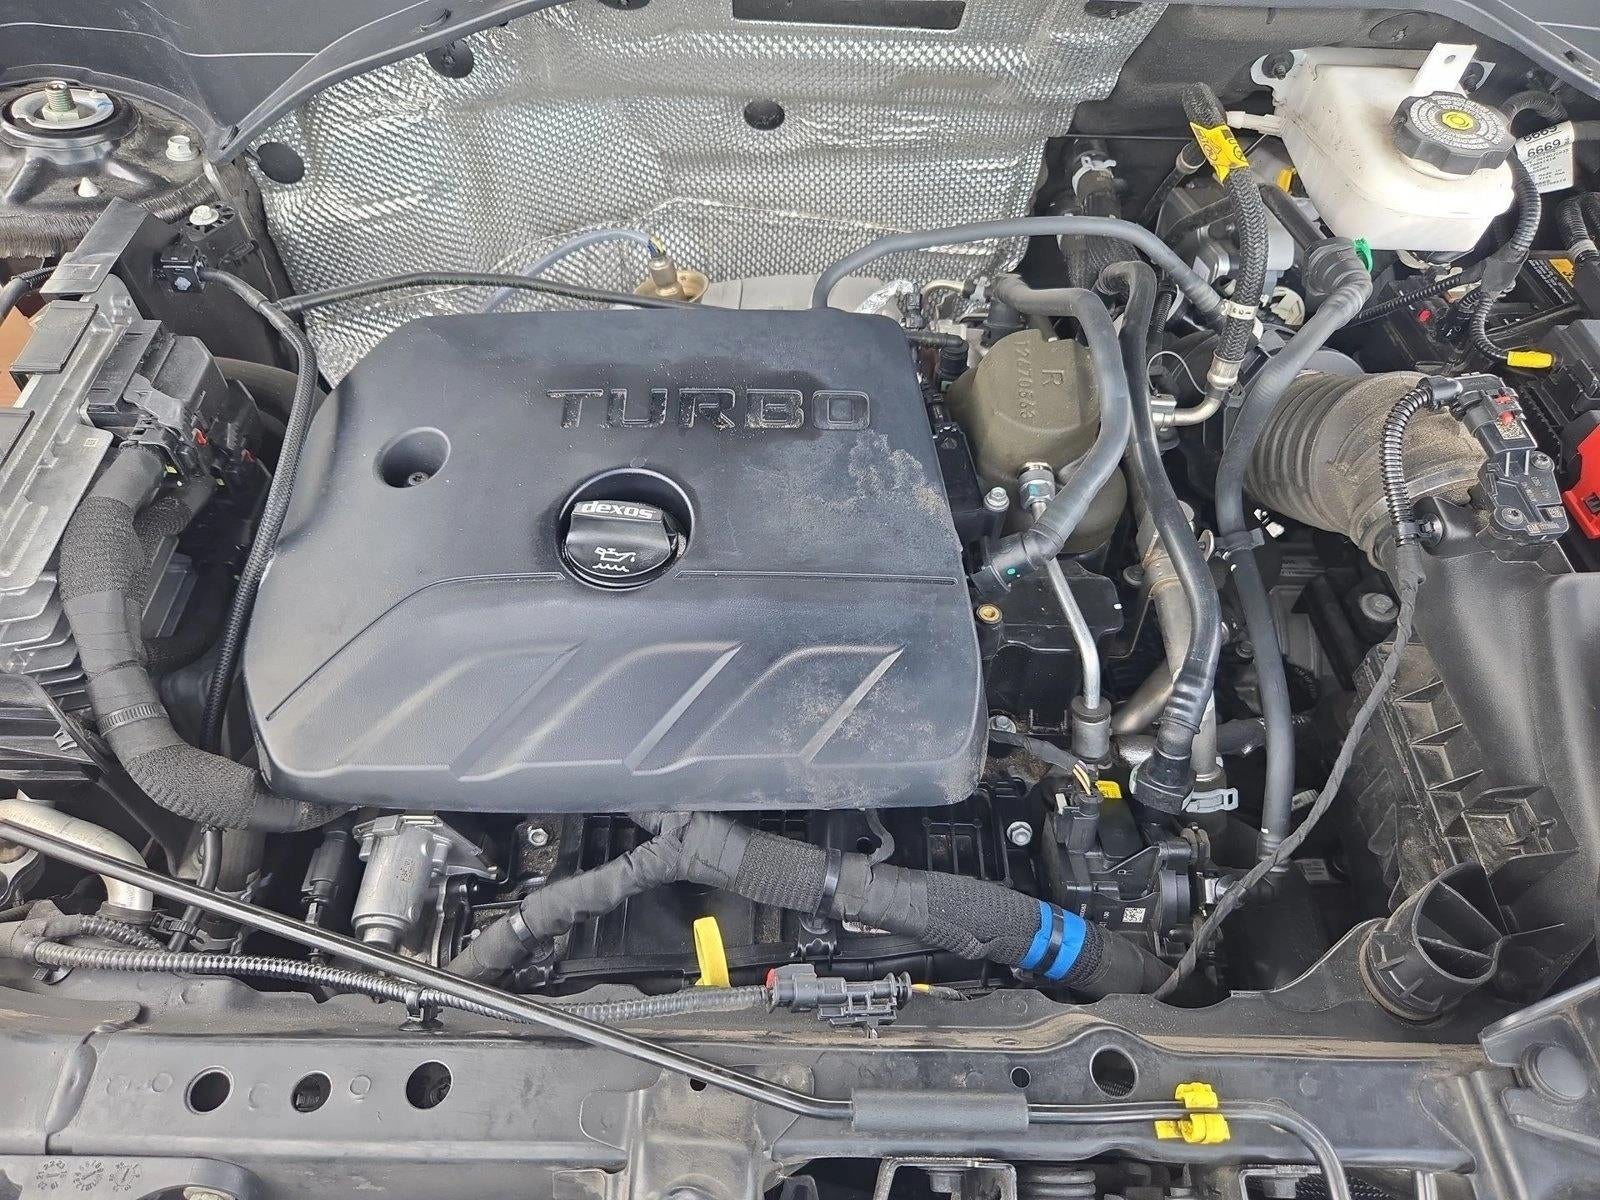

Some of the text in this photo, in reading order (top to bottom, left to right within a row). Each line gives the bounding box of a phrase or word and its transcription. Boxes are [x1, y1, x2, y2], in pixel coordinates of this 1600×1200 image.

[1527, 138, 1561, 158] 6669
[1041, 369, 1065, 386] R
[547, 388, 871, 431] TURBO
[581, 500, 657, 520] dexos
